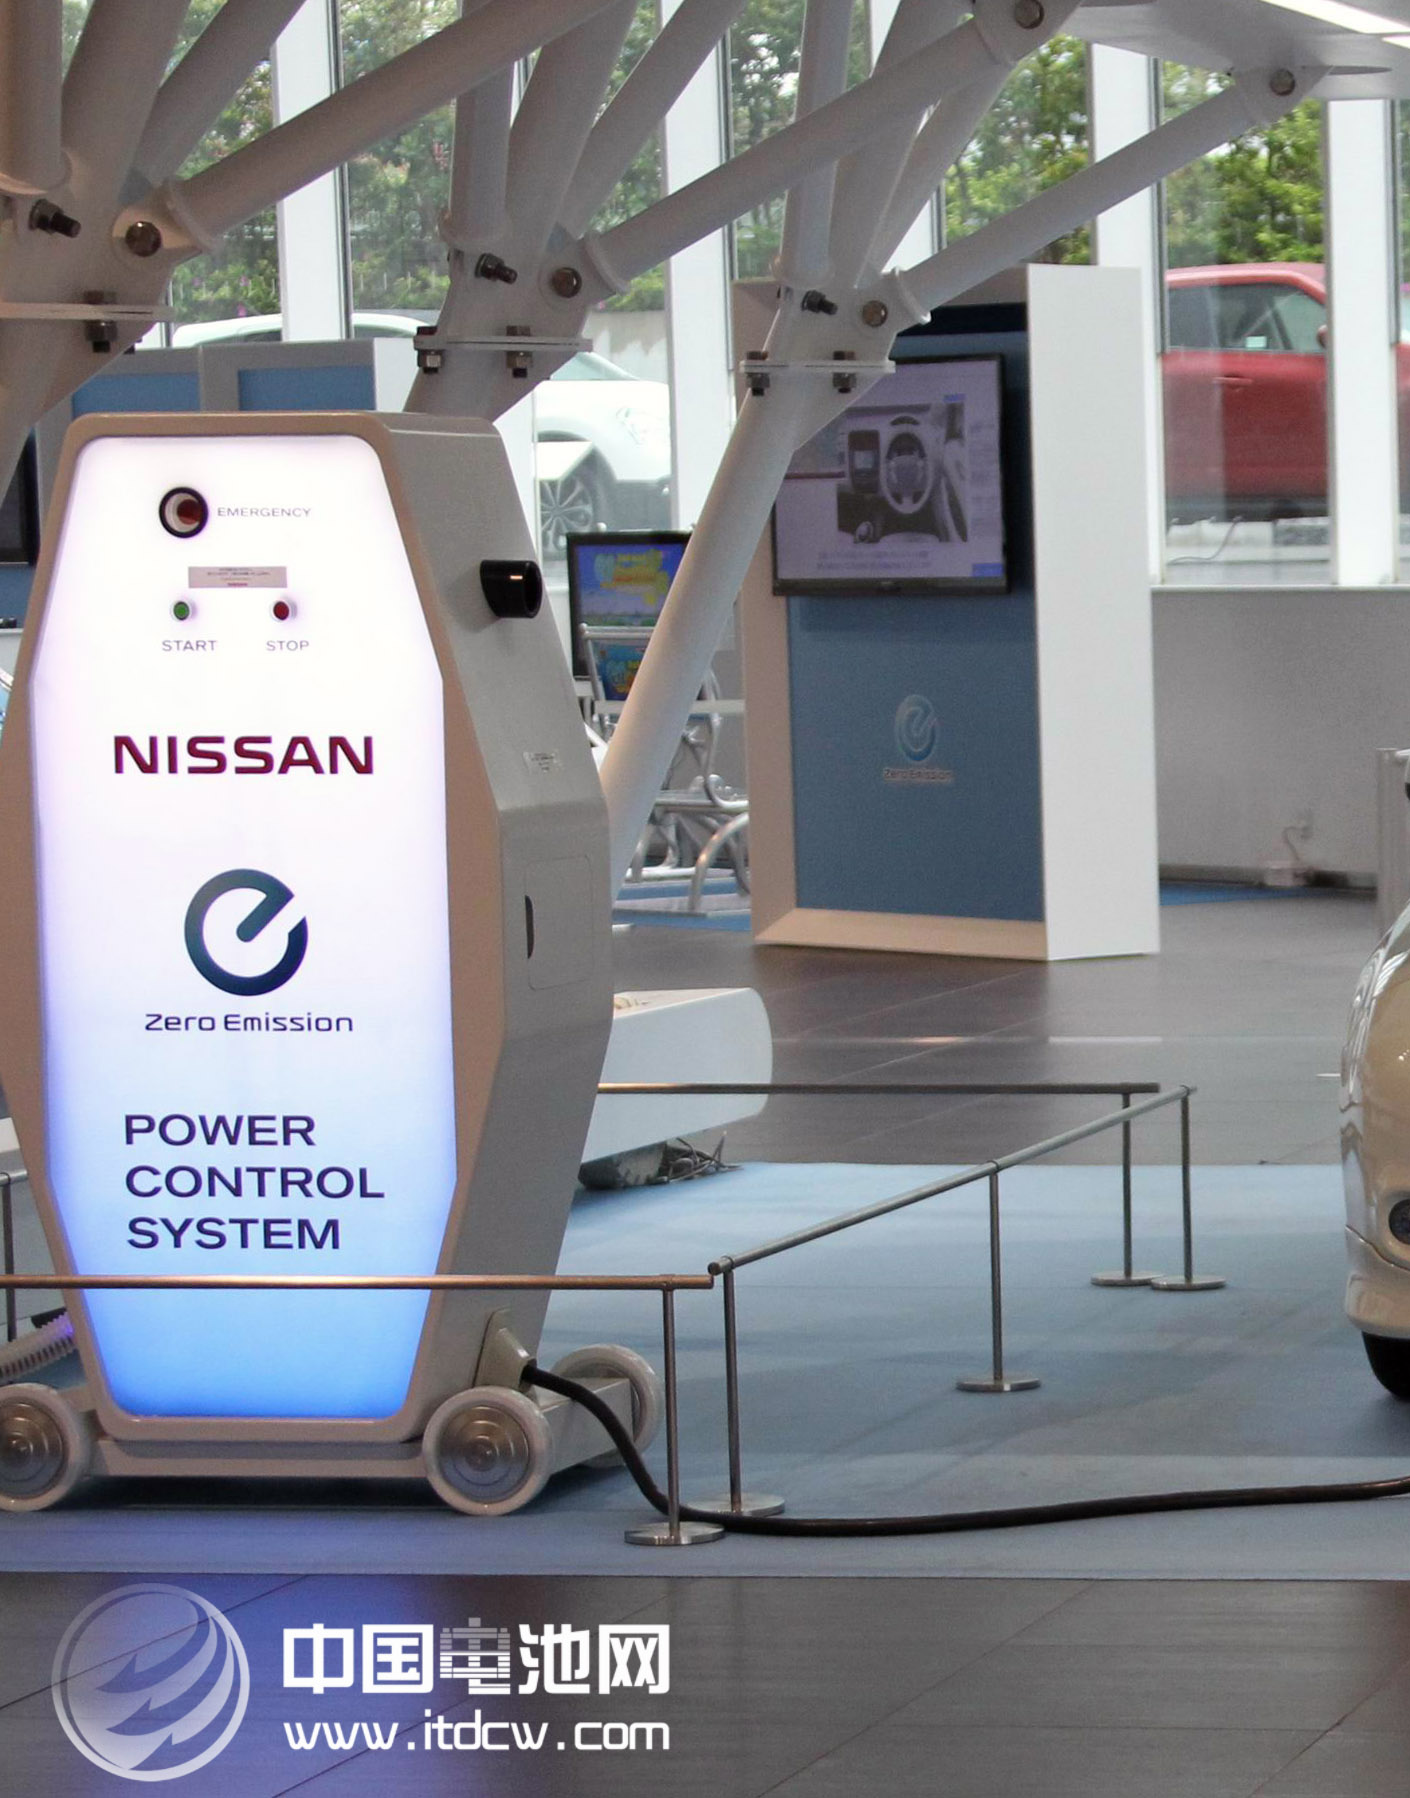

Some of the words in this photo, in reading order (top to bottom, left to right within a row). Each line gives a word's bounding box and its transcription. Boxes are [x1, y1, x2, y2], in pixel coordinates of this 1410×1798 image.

[217, 507, 312, 517] EMERGENCY
[162, 639, 217, 652] START
[266, 639, 310, 652] STOP
[114, 735, 374, 775] NISSAN
[144, 1013, 216, 1032] Zero
[223, 1012, 353, 1032] Emission
[125, 1113, 316, 1147] POWER
[125, 1165, 385, 1199] CONTROL
[127, 1216, 340, 1250] SYSTEM
